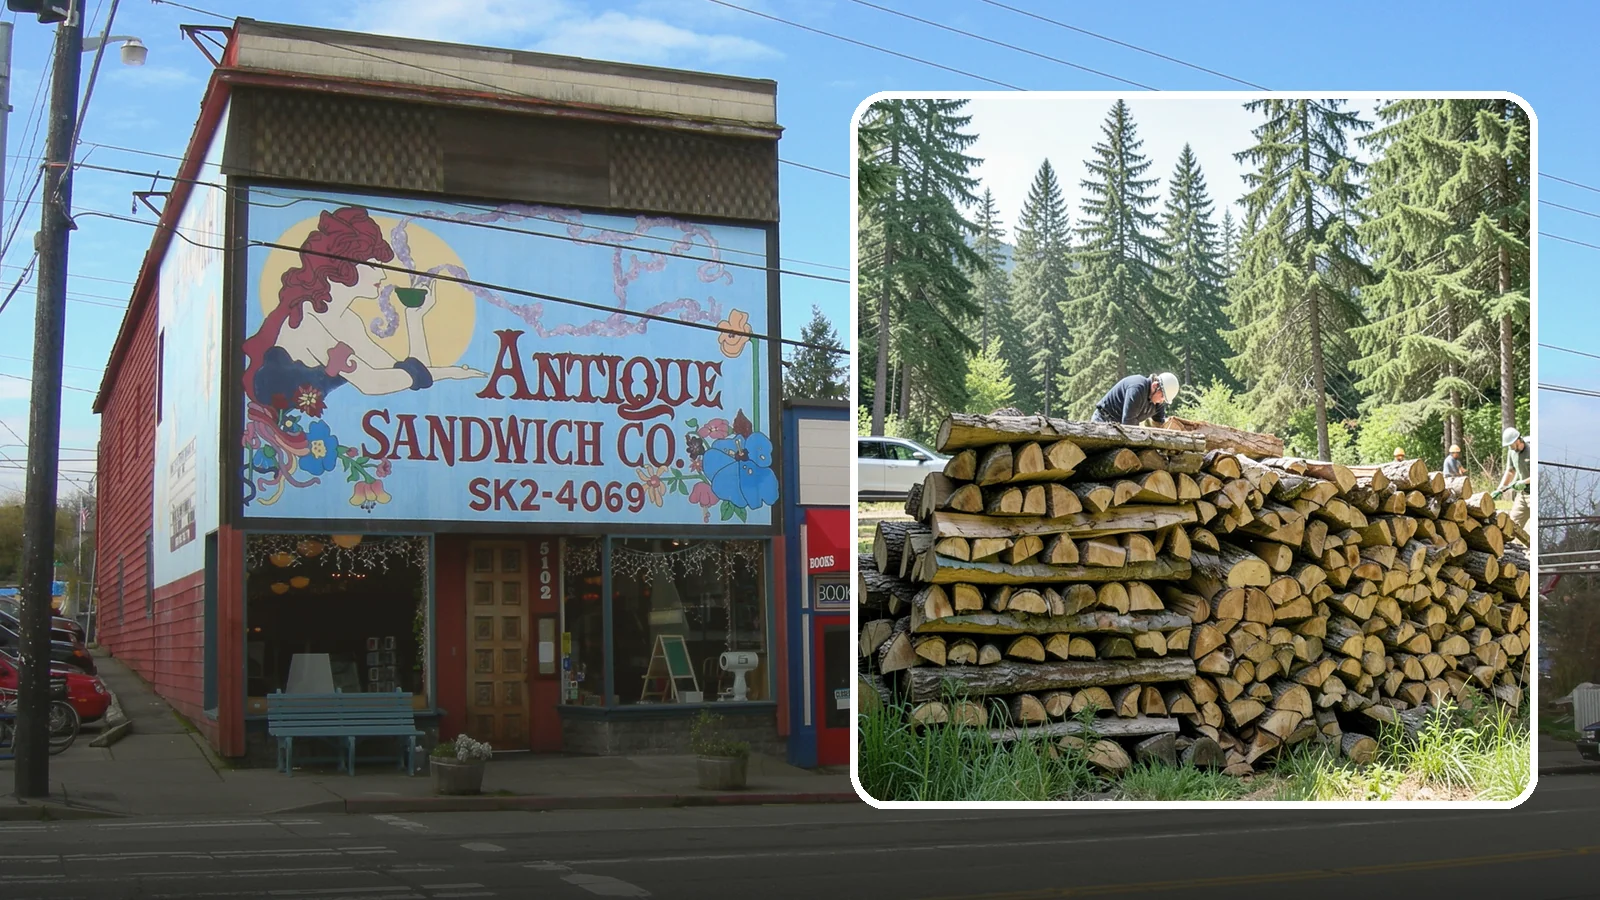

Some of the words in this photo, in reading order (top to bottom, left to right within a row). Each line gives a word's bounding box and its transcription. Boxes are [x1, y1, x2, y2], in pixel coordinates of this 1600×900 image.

[476, 329, 723, 420] ANTIQUE
[361, 408, 605, 467] SANDWICH
[617, 422, 685, 469] CO.
[468, 477, 646, 513] SK2-4069
[540, 541, 551, 600] 5102
[809, 555, 835, 569] BOOKS
